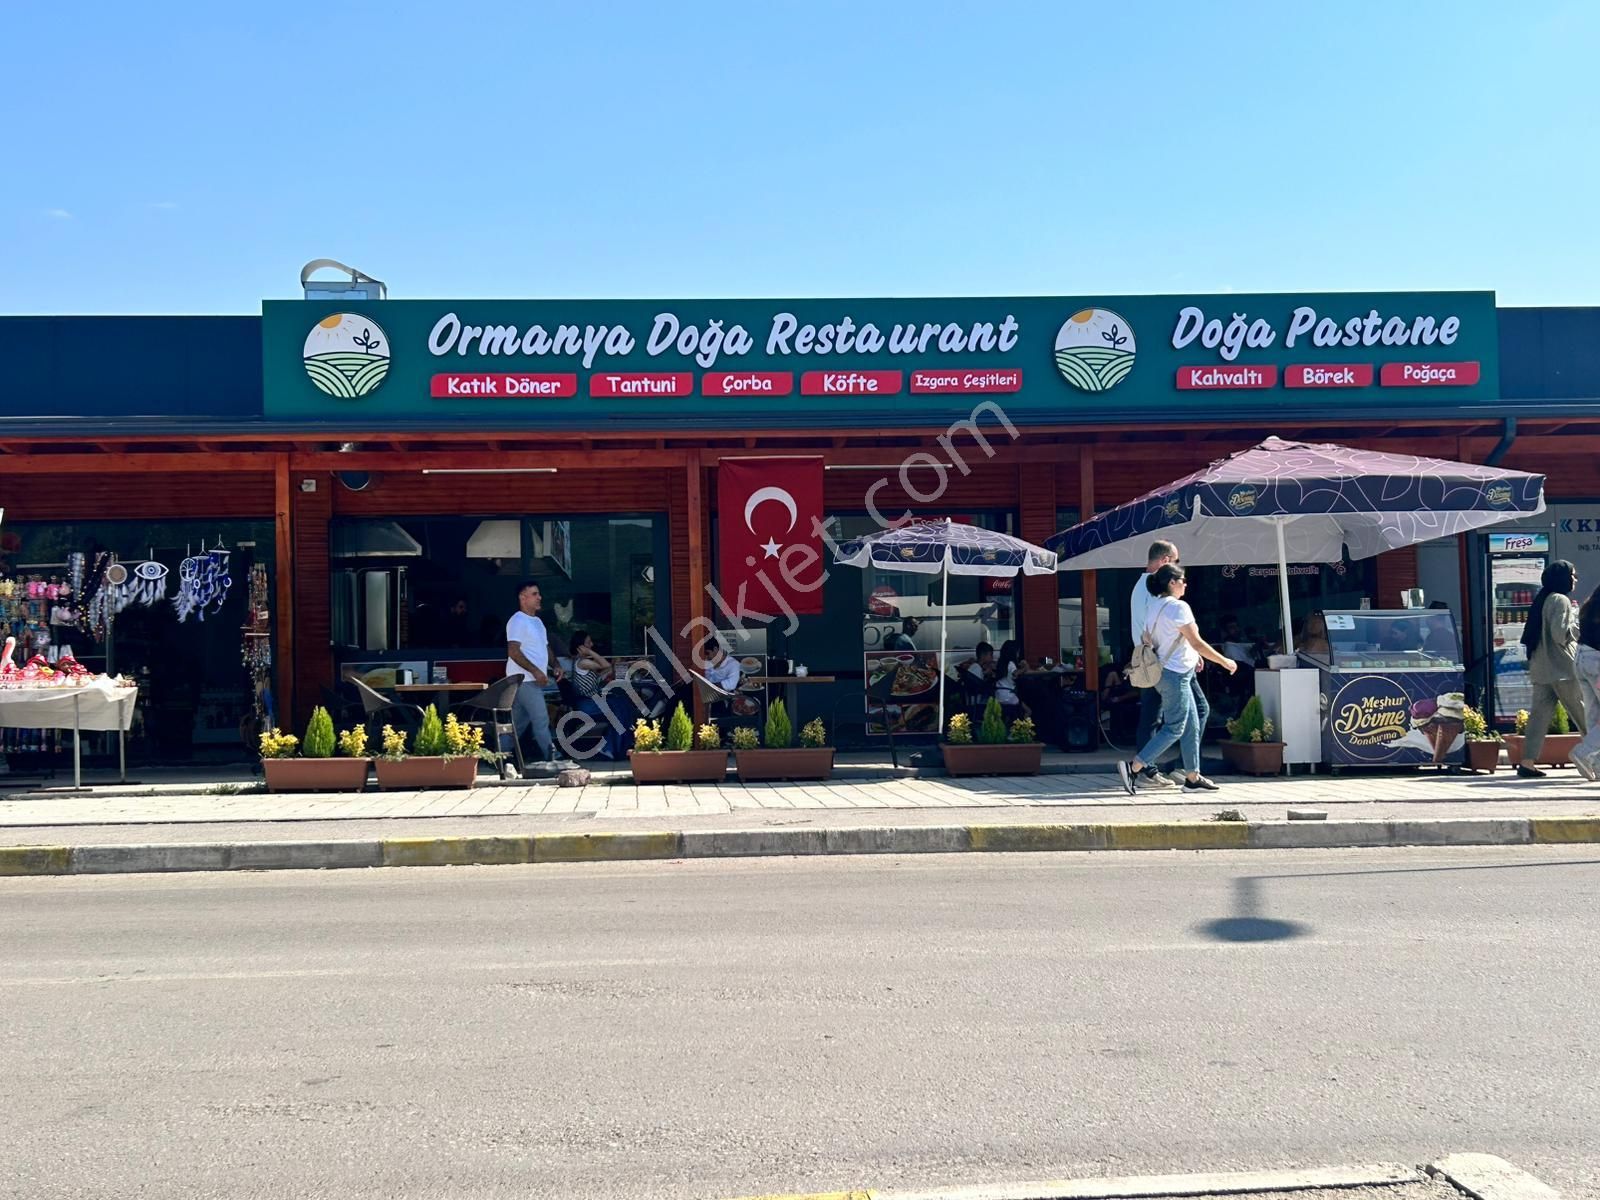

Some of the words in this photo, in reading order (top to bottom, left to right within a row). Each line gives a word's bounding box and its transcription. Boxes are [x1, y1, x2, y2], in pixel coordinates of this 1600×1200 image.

[429, 312, 635, 368] Ormanya
[647, 312, 753, 368] Doğa
[766, 313, 1019, 355] Restaurant
[1172, 306, 1275, 361] Doğa
[1286, 307, 1460, 348] Pastane
[823, 374, 878, 393] Köfte
[963, 373, 1017, 390] Çeşitleri
[1191, 368, 1262, 386] Kahvaltı
[1303, 368, 1355, 385] Börek
[1403, 365, 1456, 384] Poğaça
[448, 377, 497, 394] Katık
[505, 376, 561, 394] Döner
[606, 376, 676, 393] Tantuni
[722, 375, 772, 394] Çorba
[1361, 696, 1406, 710] Meşhur
[1335, 704, 1406, 734] Dövme
[1349, 732, 1397, 746] Dondurma
